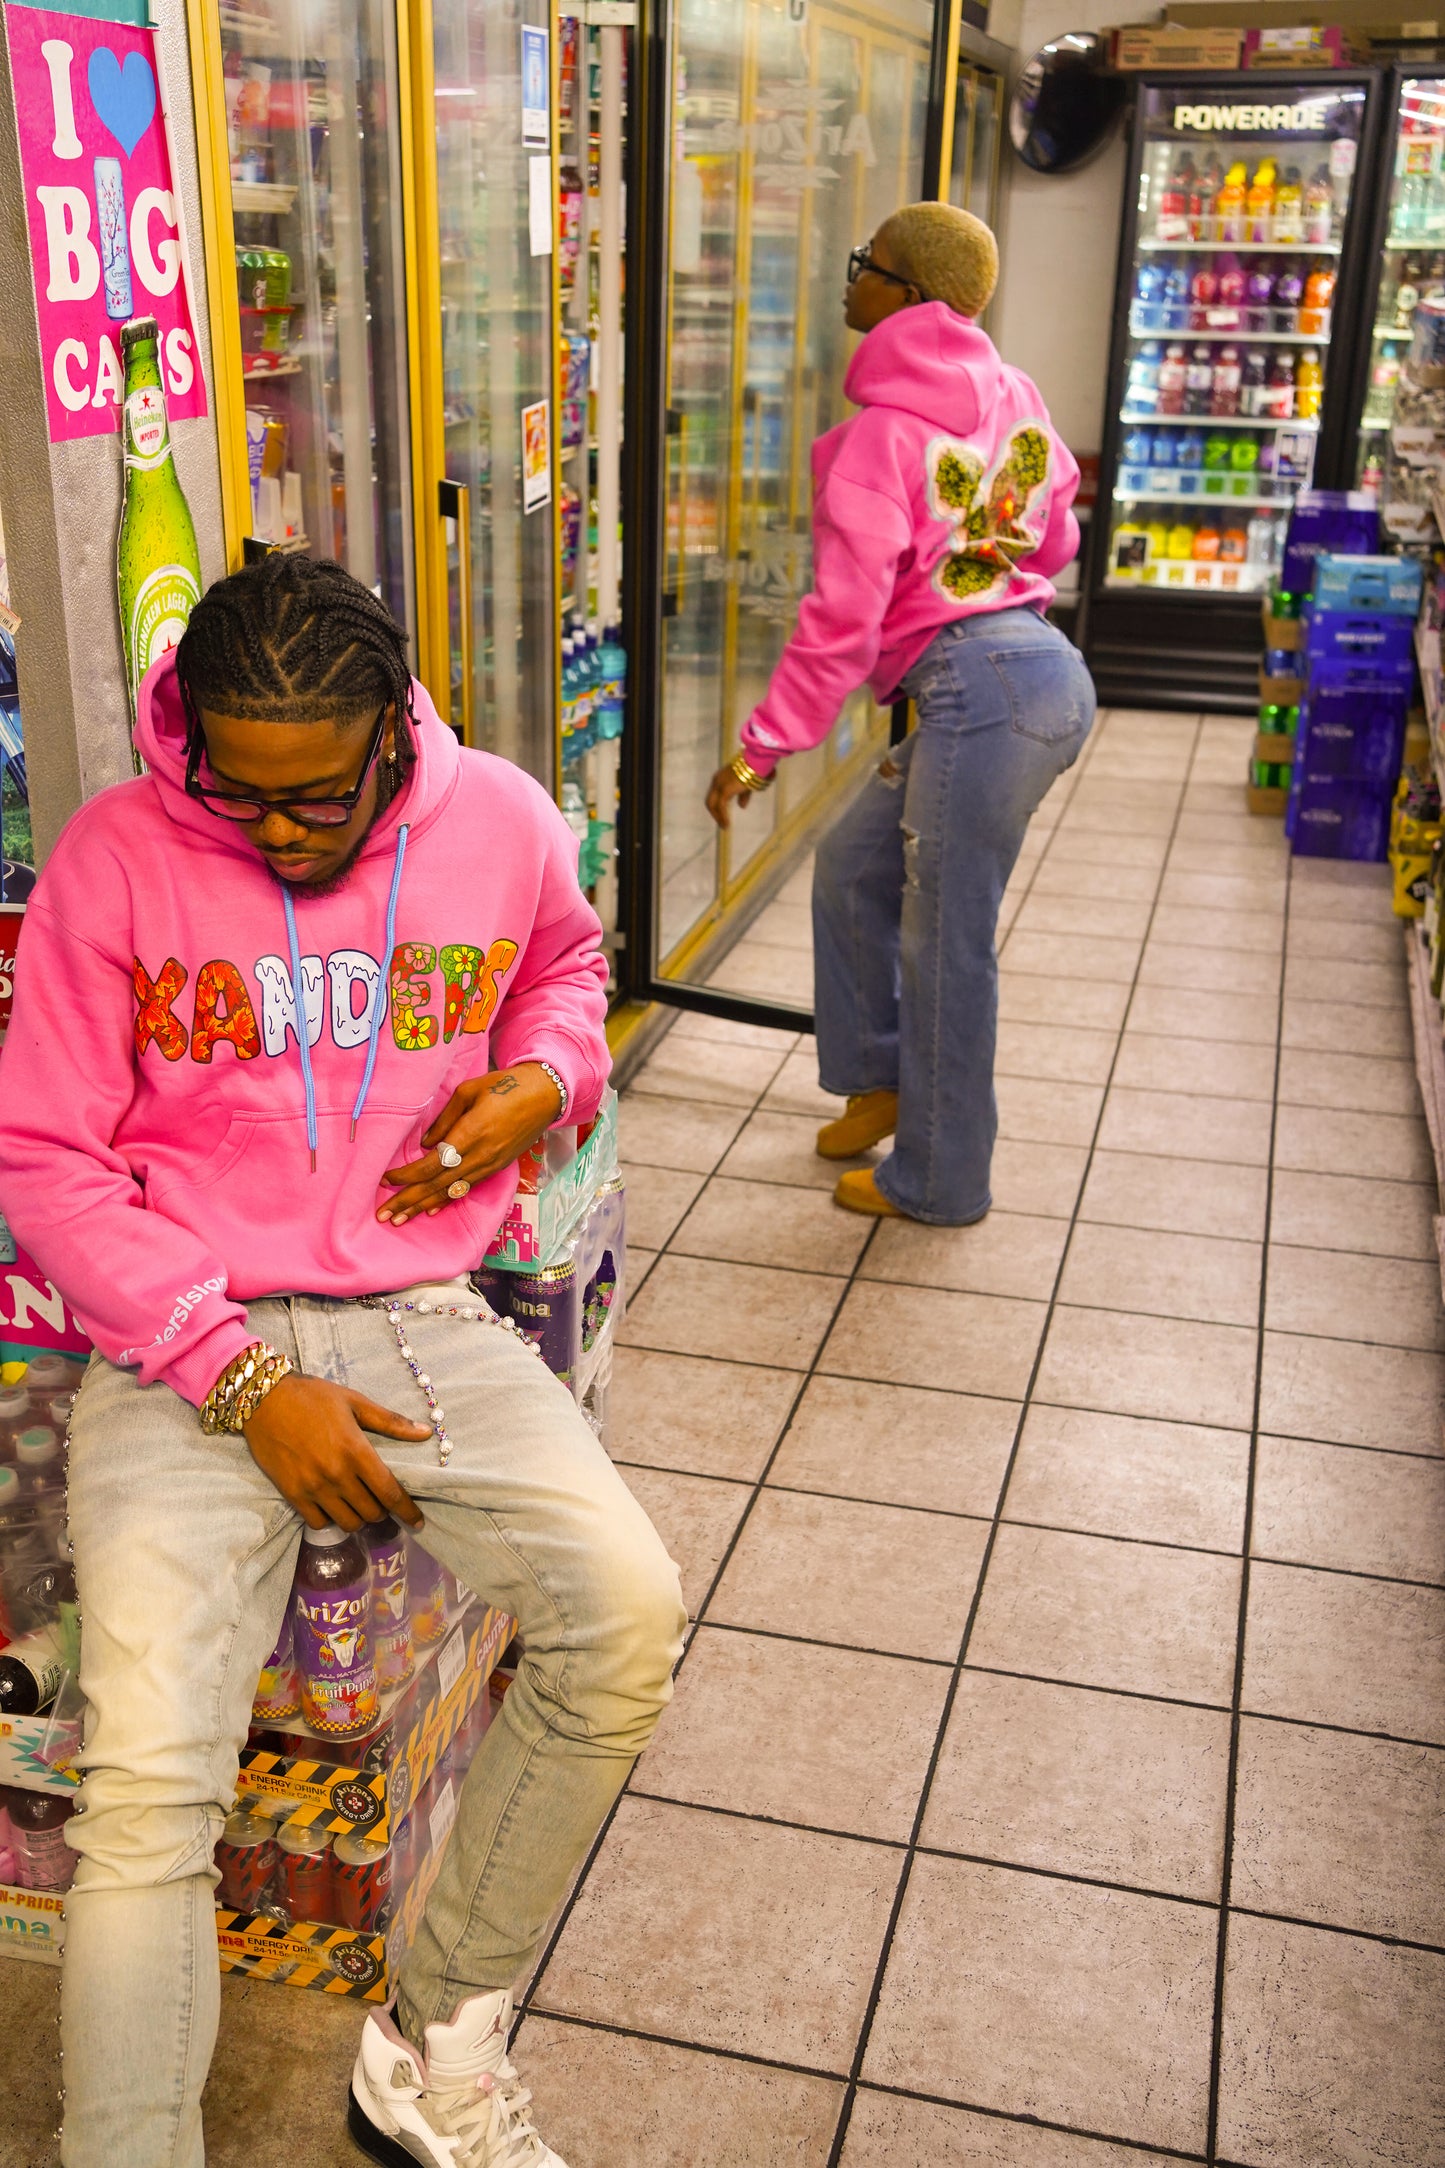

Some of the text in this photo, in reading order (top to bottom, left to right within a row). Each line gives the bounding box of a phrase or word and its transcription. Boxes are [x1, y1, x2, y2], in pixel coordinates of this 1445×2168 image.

[41, 39, 83, 160] I
[1174, 105, 1328, 131] POWERADE
[53, 328, 195, 412] CAS
[161, 591, 188, 615] LAGER
[133, 937, 520, 1065] XANDERS
[311, 1680, 344, 1699] Fruit
[250, 1773, 291, 1789] ENERGY
[294, 1782, 327, 1797] DRINK
[336, 1784, 373, 1802] AriZona
[335, 1797, 376, 1821] ENERGY DRINK
[247, 1936, 290, 1950] ENERGY
[334, 1946, 372, 1964] AriZona
[358, 1963, 375, 1981] DRINK
